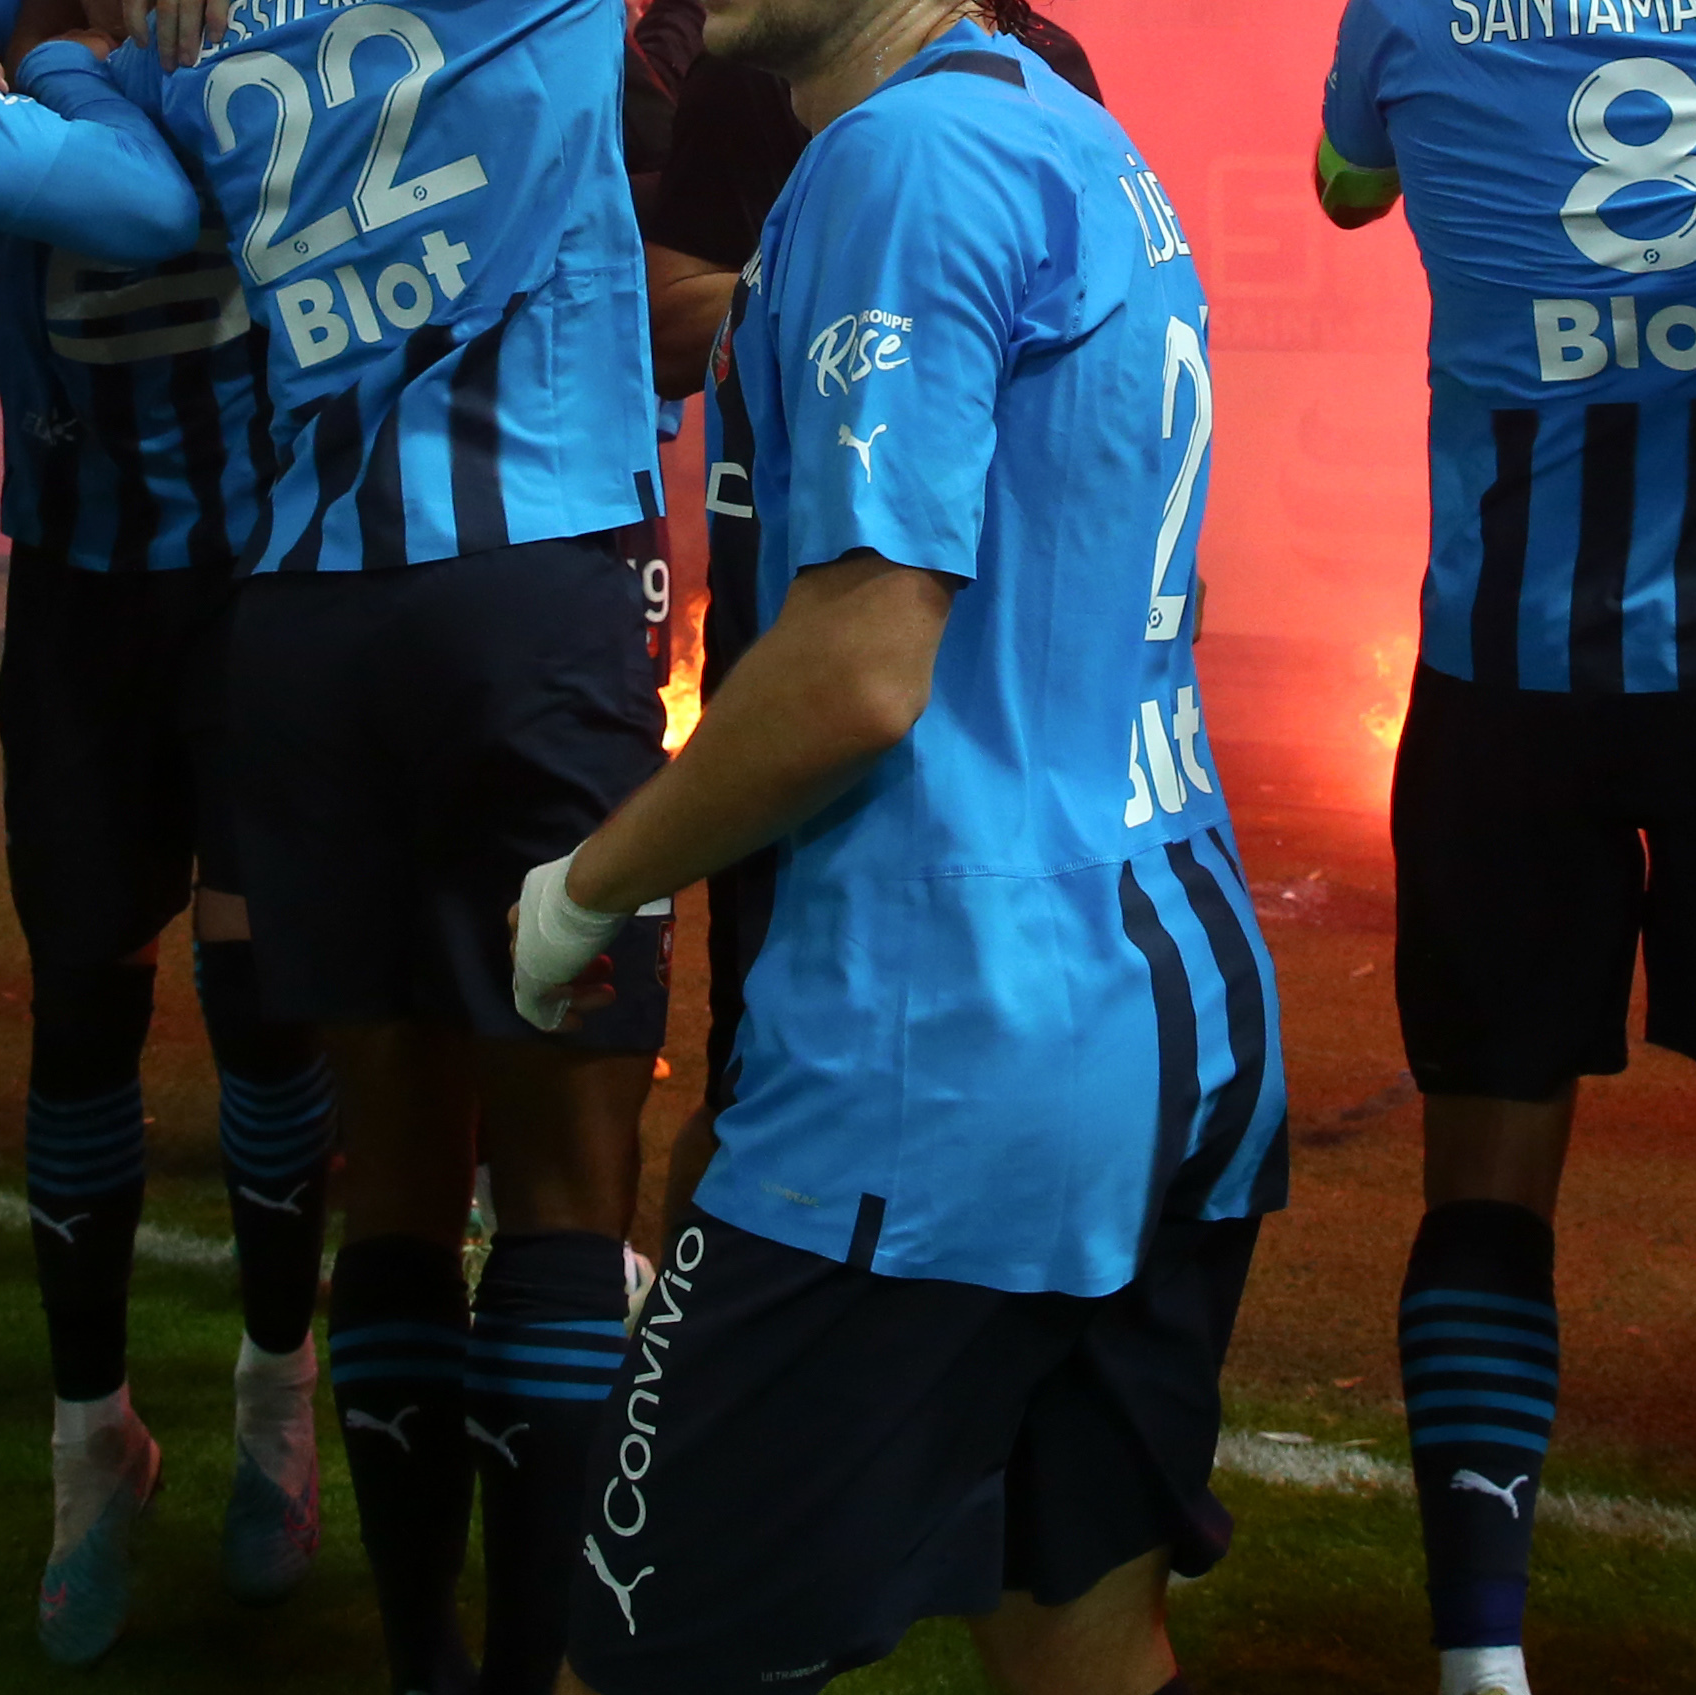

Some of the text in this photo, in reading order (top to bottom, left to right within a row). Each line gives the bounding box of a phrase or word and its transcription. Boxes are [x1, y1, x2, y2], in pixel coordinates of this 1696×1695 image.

[203, 4, 489, 287] 22
[275, 229, 472, 369] Blot
[626, 558, 670, 623] 9
[603, 1226, 705, 1538] Convivio
